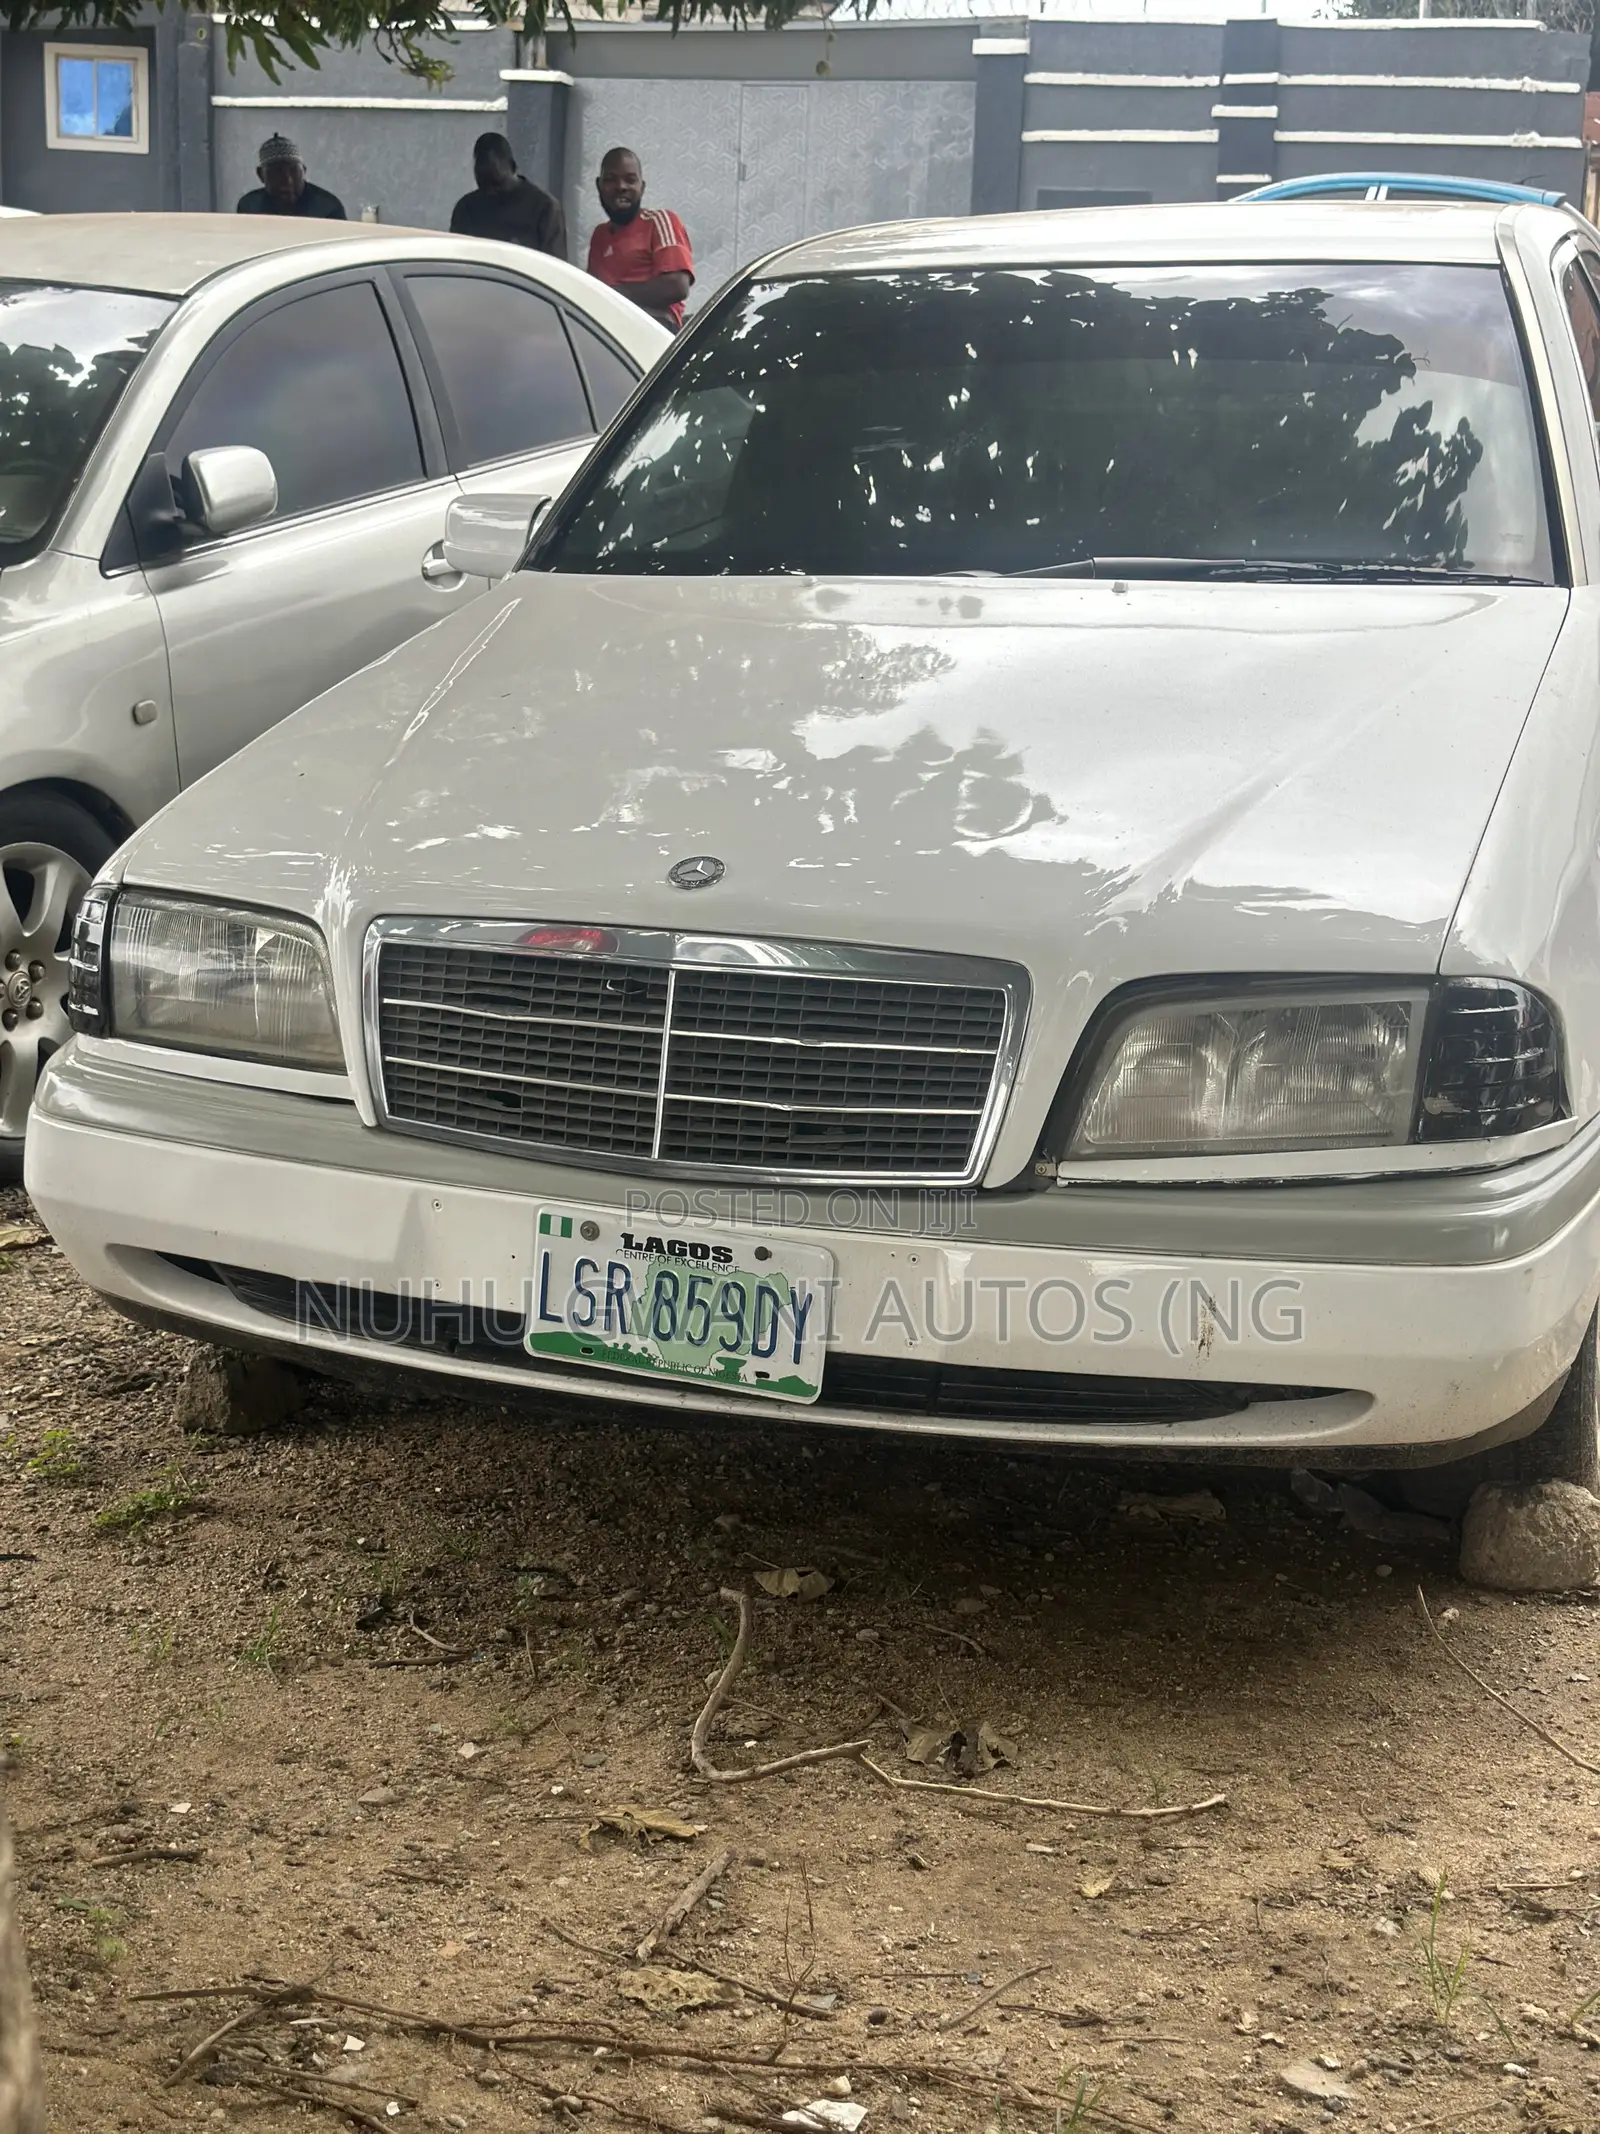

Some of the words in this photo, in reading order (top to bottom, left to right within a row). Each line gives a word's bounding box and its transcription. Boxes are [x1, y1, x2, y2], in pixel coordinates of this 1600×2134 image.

[615, 1248, 655, 1263] CENTRE
[658, 1254, 672, 1267] OF
[674, 1257, 740, 1274] EXCELLENCE
[620, 1232, 734, 1264] LAGOS
[539, 1250, 632, 1335] LSR
[653, 1269, 813, 1365] 859DY
